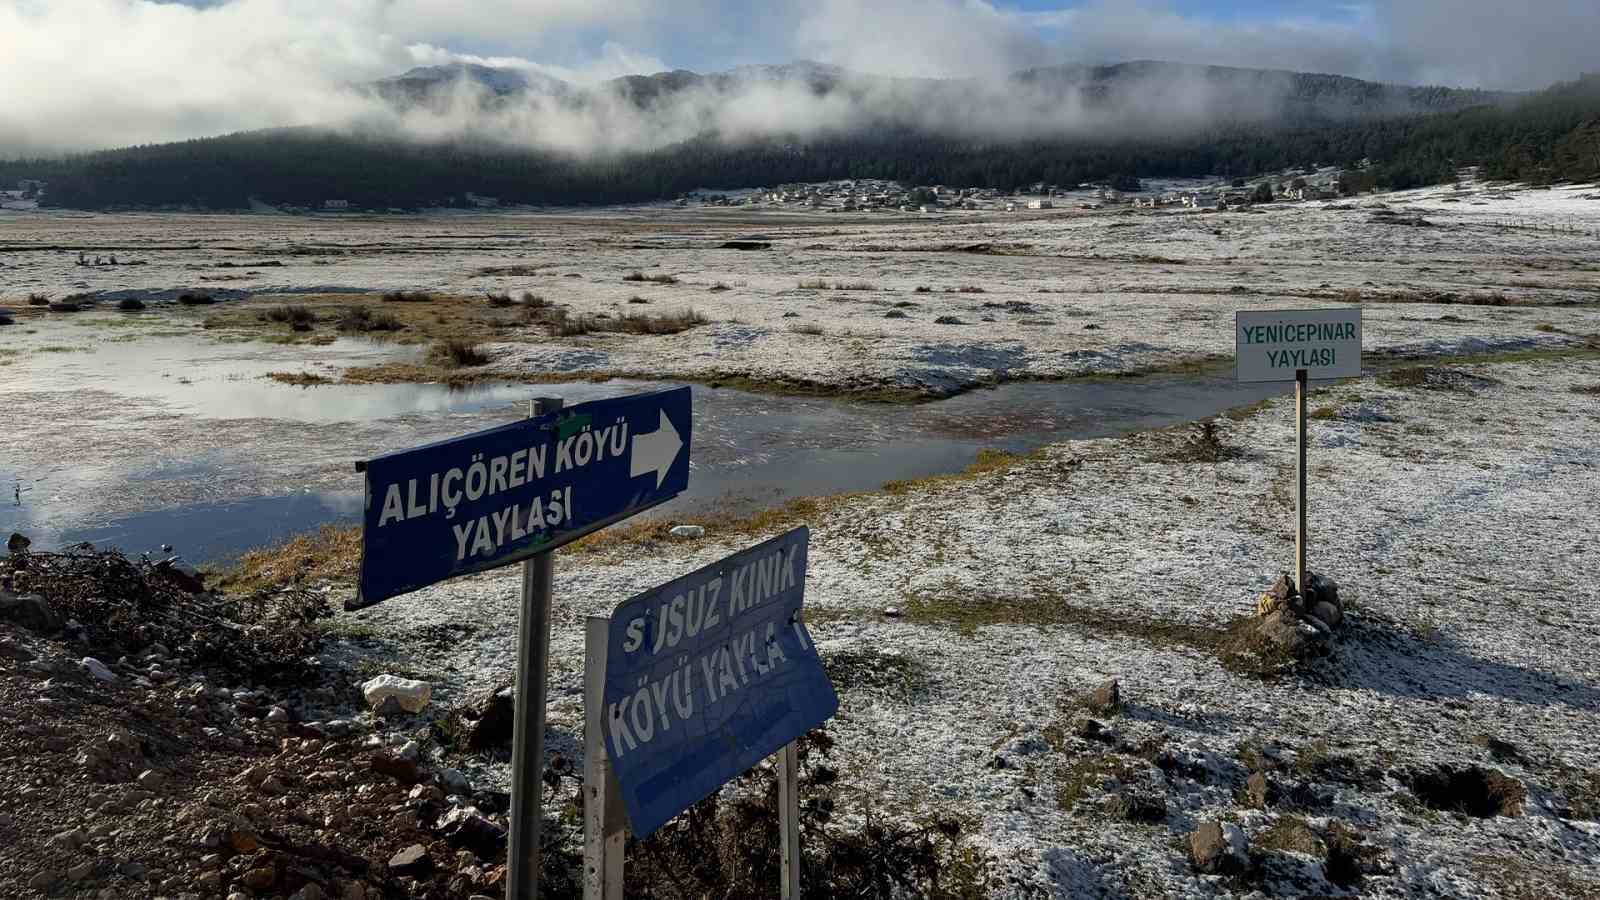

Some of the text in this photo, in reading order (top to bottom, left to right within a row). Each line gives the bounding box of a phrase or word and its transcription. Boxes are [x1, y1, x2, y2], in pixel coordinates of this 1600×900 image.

[1242, 321, 1356, 344] YENİCEPINAR
[1267, 348, 1336, 368] YAYLASI
[378, 416, 629, 528] ALIÇÖREN KÖYÜ
[452, 485, 572, 561] YAYLASI
[729, 544, 798, 617] KINIK
[608, 620, 809, 758] KÖYÜ YAYLAI
